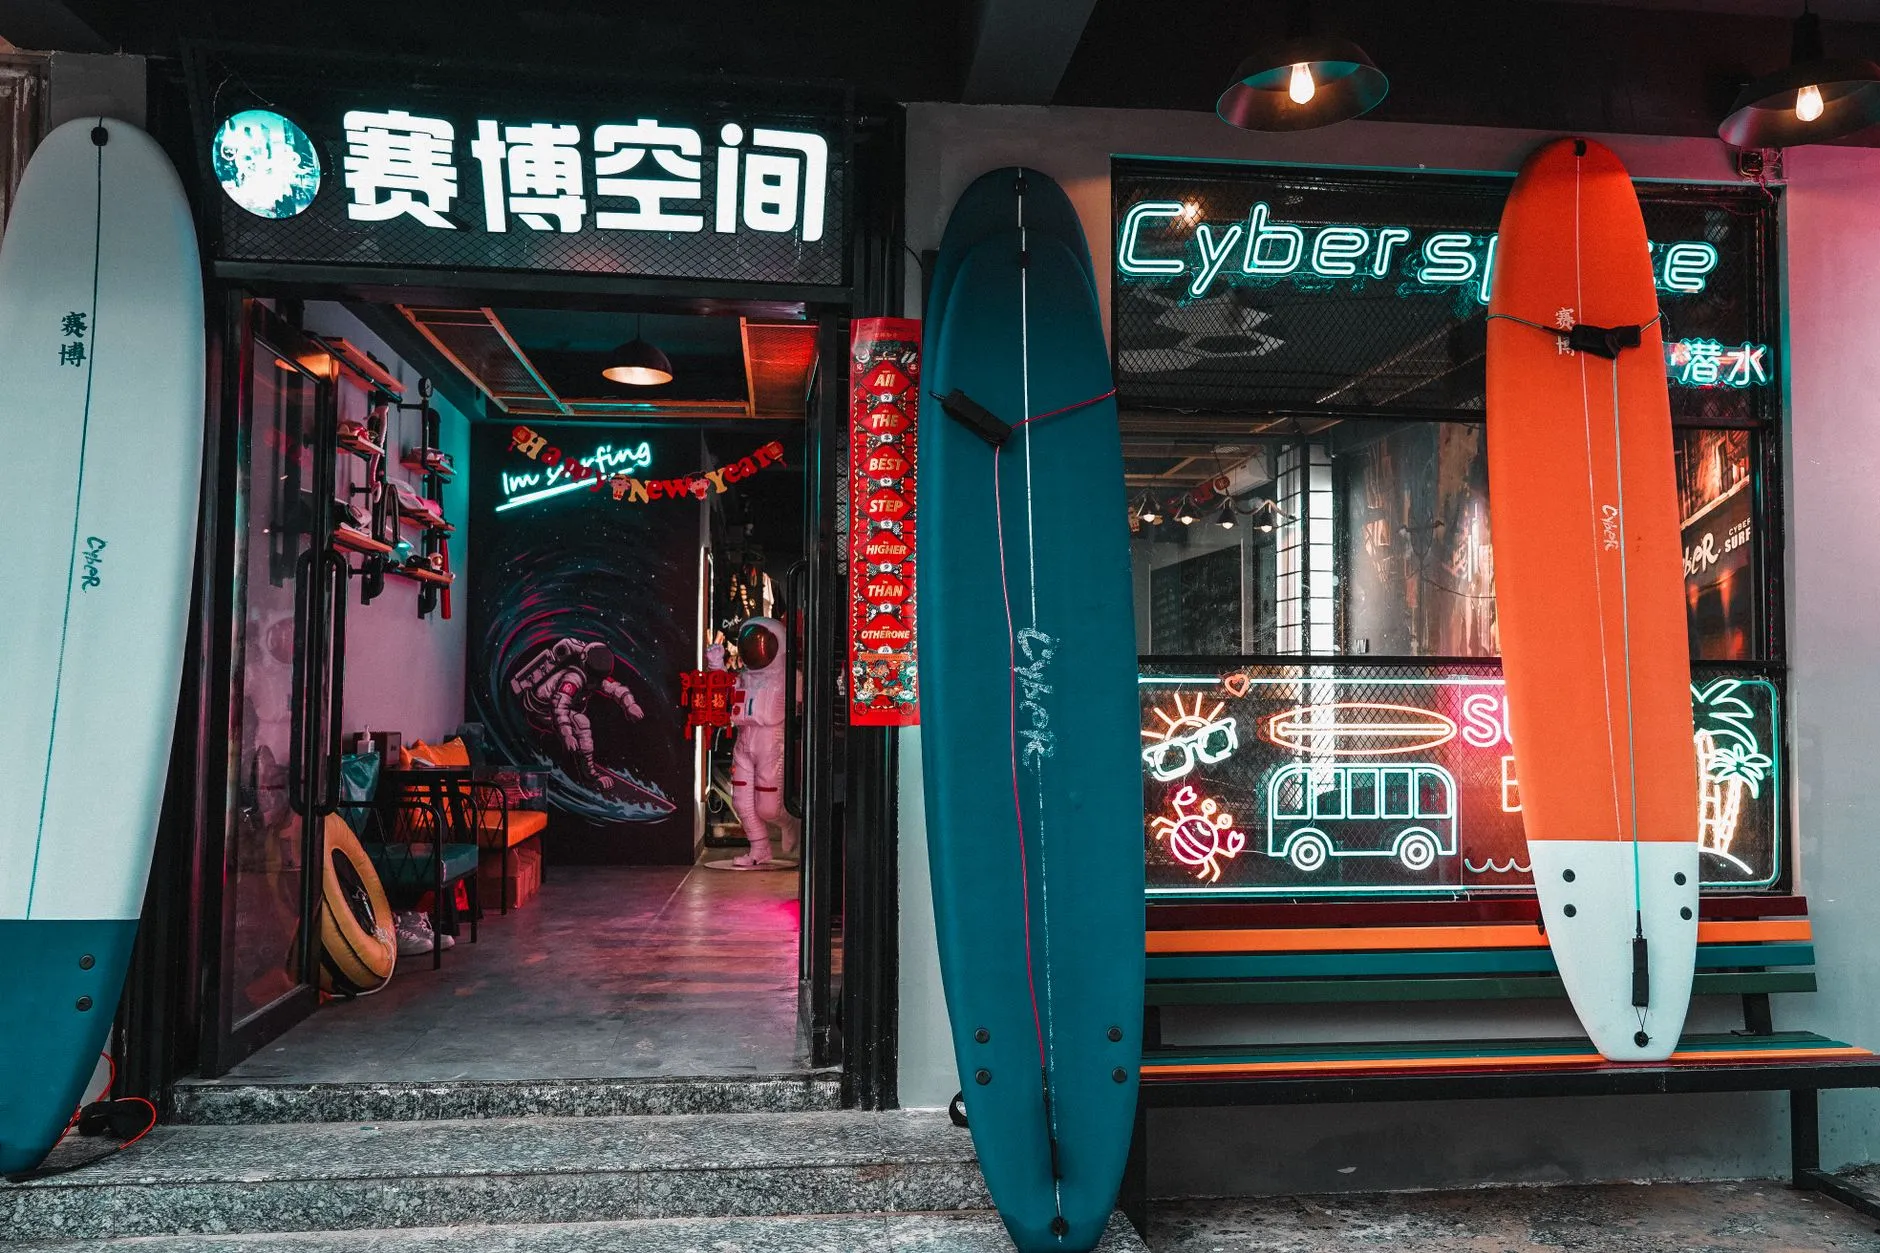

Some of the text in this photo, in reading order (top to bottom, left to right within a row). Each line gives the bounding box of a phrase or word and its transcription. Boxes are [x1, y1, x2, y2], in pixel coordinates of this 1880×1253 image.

[343, 109, 828, 242] 赛博空间
[1119, 200, 1717, 302] Cyberse
[58, 311, 88, 368] 赛博
[1681, 341, 1766, 386] 潜水
[871, 414, 899, 428] THE
[868, 457, 902, 471] BEST
[628, 478, 691, 505] New
[869, 499, 903, 513] STEP
[866, 544, 907, 556] HIGHER
[867, 585, 904, 597] THAN
[861, 629, 911, 640] OTHERONE
